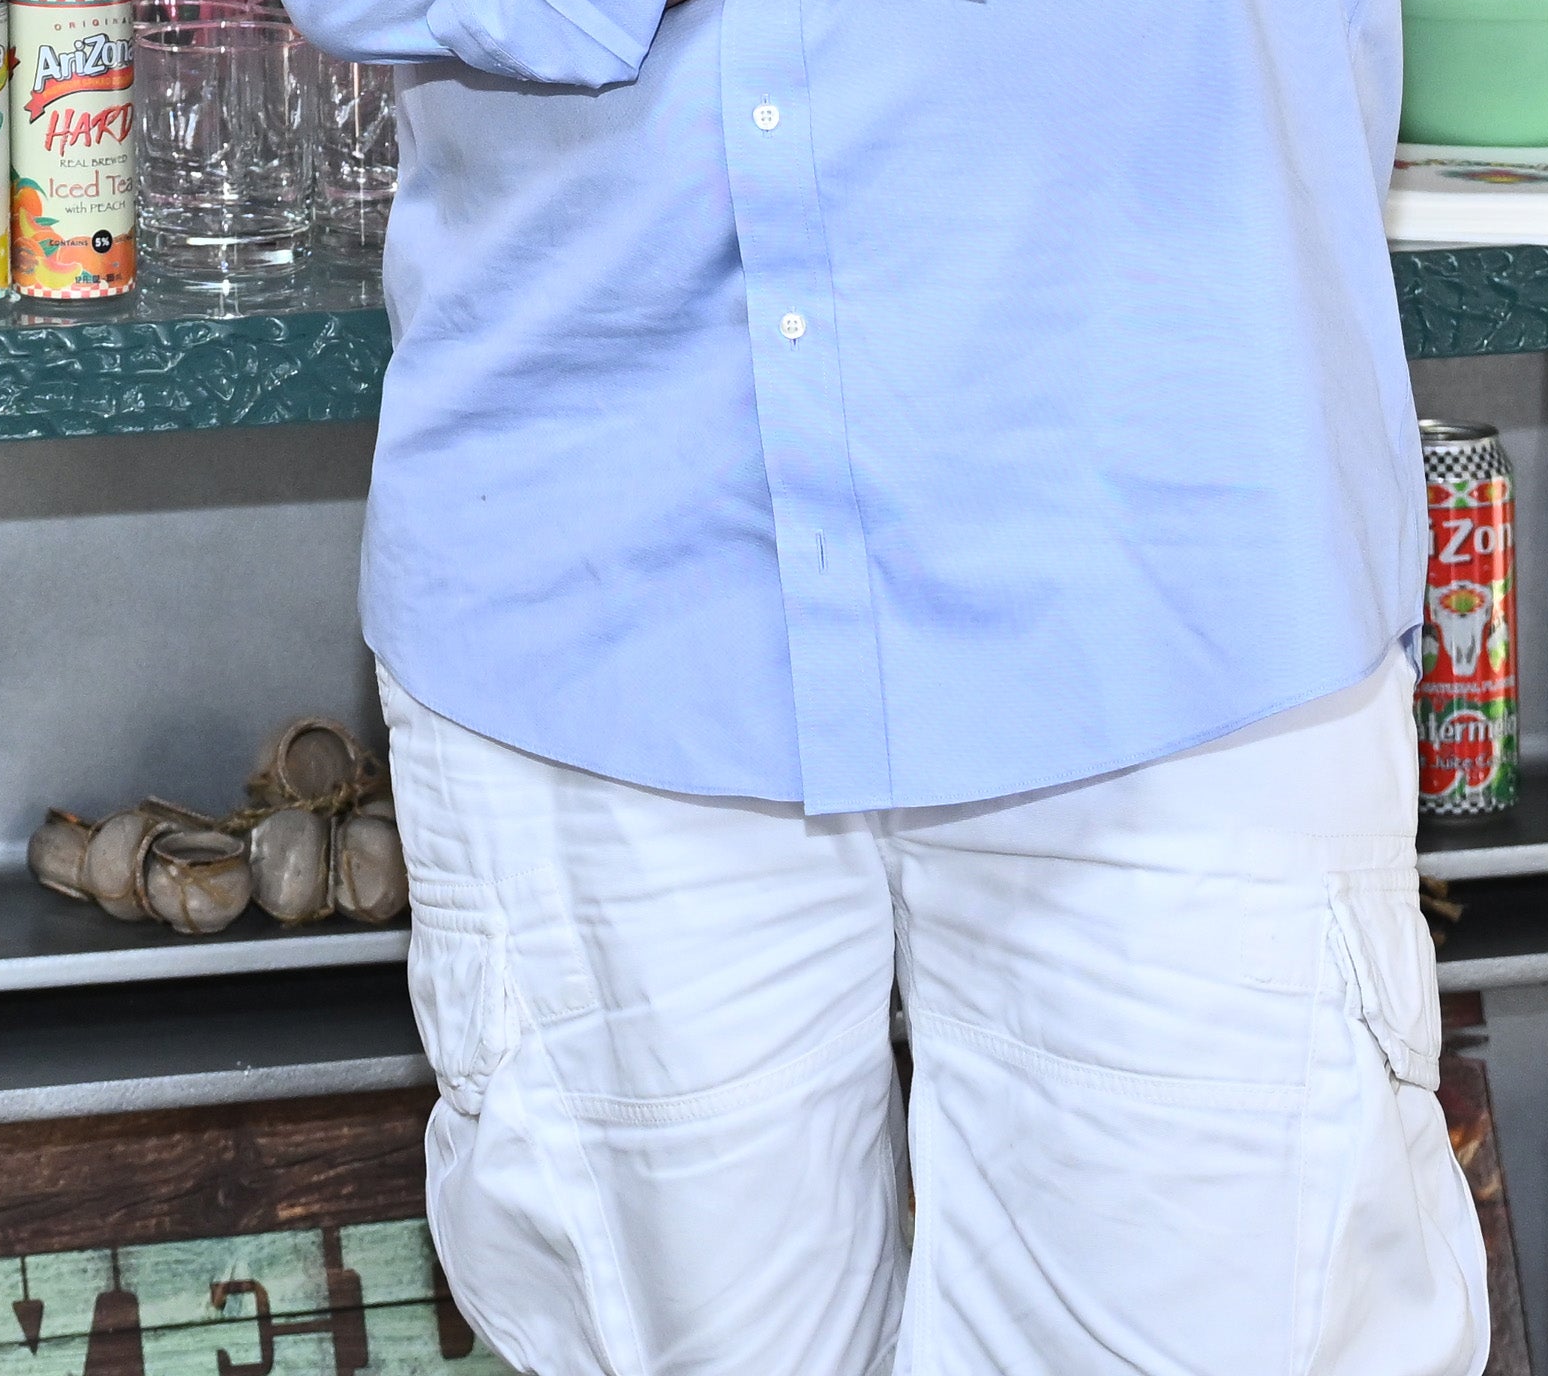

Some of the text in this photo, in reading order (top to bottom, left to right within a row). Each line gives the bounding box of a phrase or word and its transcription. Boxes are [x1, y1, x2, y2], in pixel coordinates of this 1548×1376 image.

[44, 102, 133, 157] HARD
[60, 154, 128, 168] REAL BREWED
[49, 169, 133, 198] Iced Tea
[65, 200, 126, 215] with PEACH
